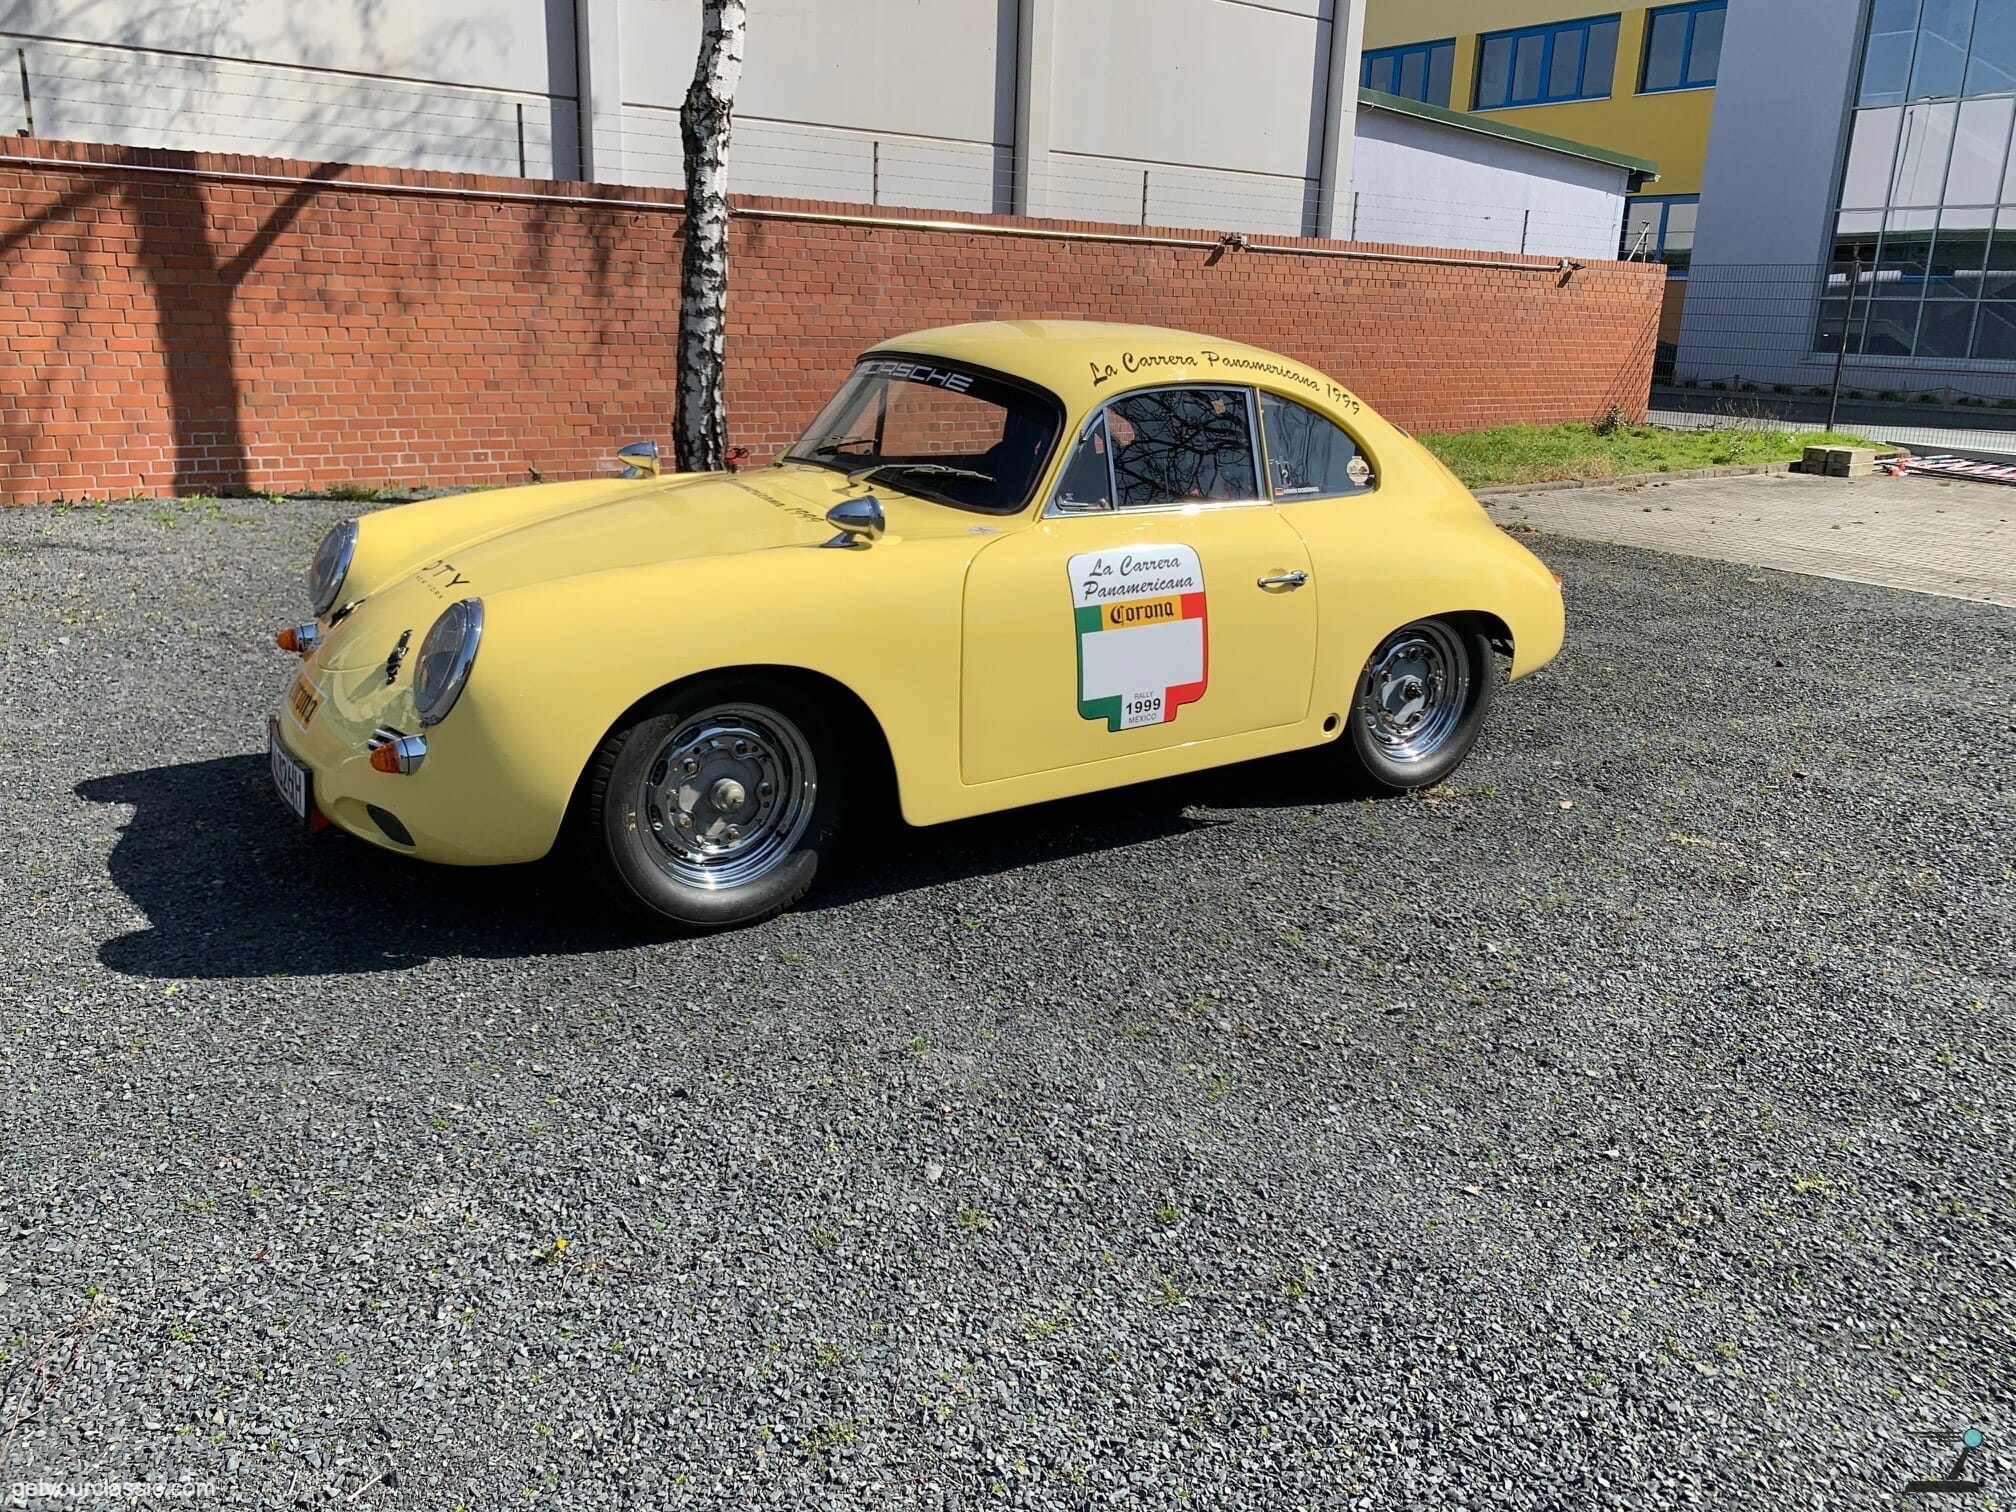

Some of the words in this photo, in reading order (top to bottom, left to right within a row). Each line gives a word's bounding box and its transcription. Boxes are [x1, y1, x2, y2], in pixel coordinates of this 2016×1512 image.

[1090, 361, 1117, 387] La
[1122, 352, 1198, 373] Carrera
[1201, 350, 1321, 392] Panamericana
[1326, 383, 1360, 415] 1999
[1089, 558, 1114, 577] La
[1119, 555, 1181, 577] Carrera
[1083, 576, 1194, 601] Panamericana
[1110, 601, 1174, 626] Corona
[1126, 697, 1161, 715] 1999
[1134, 690, 1154, 700] RALLY
[1128, 712, 1157, 724] MEXICO
